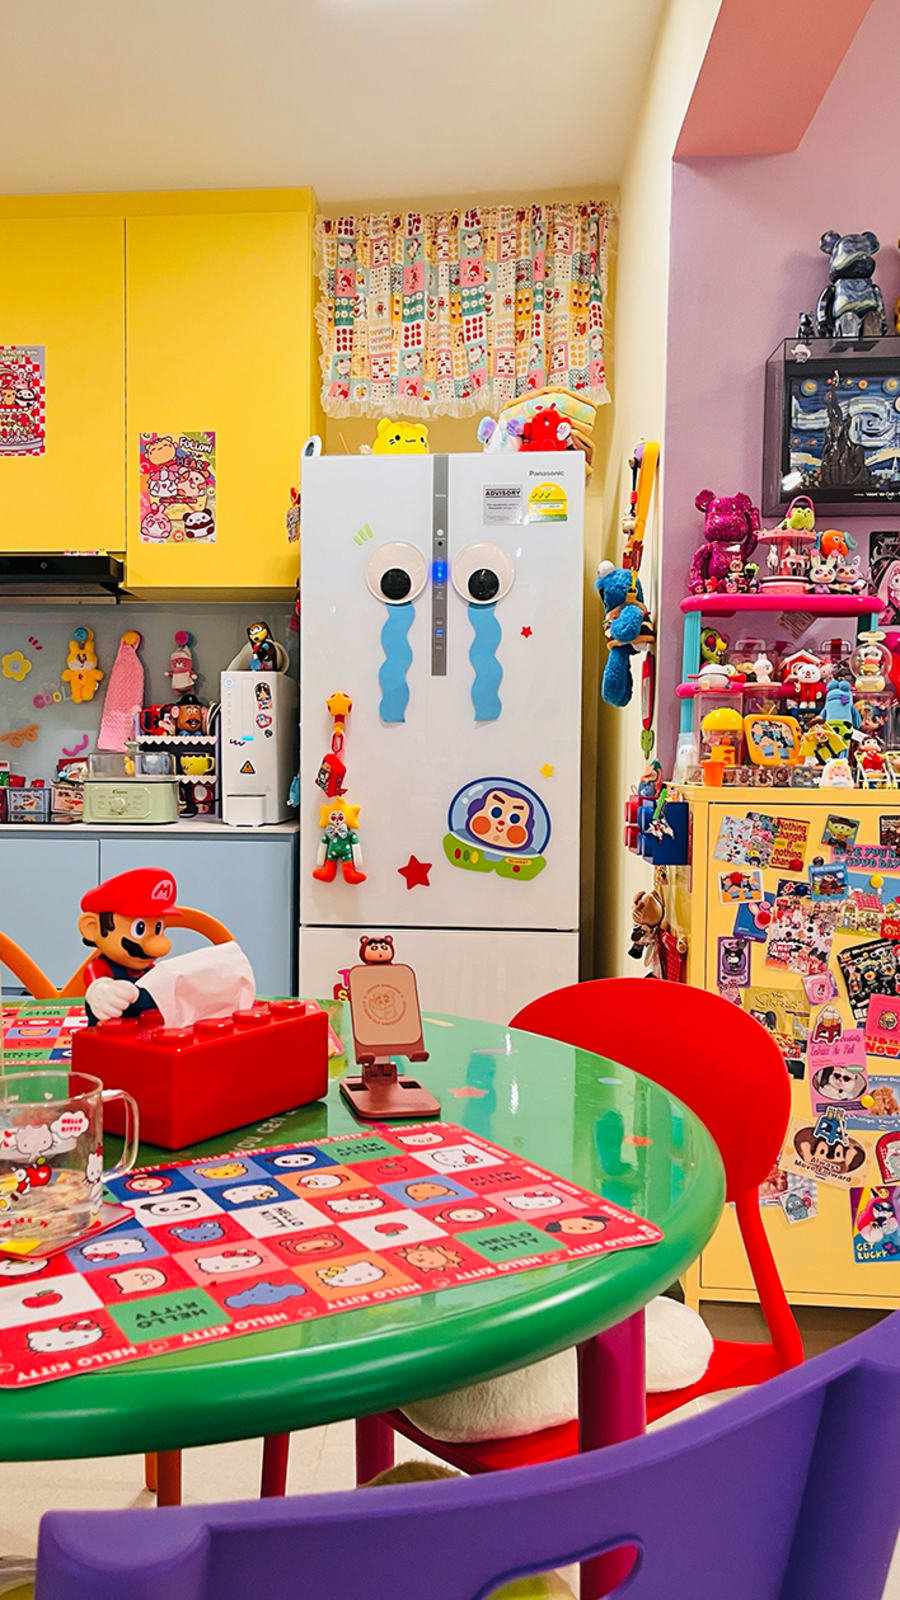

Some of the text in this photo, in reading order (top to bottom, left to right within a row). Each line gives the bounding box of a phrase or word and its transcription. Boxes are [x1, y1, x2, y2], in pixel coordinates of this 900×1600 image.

[180, 437, 213, 454] FOLLOW
[176, 456, 210, 471] HEART
[294, 1138, 330, 1147] HELLO
[192, 1148, 265, 1165] HELLO KITTY
[478, 1231, 532, 1247] HELLO
[488, 1237, 539, 1252] KITTY
[856, 1242, 875, 1252] GET
[567, 1243, 603, 1256] KITTY
[857, 1249, 888, 1260] LUCKY
[455, 1256, 542, 1281] HELLO KITTY
[327, 1282, 422, 1310] HELLO KITTY
[136, 1301, 198, 1320] KITTY
[136, 1308, 208, 1328] HELLO
[181, 1312, 288, 1343] HELLO KITTY
[17, 1346, 137, 1382] HELLO KITTY
